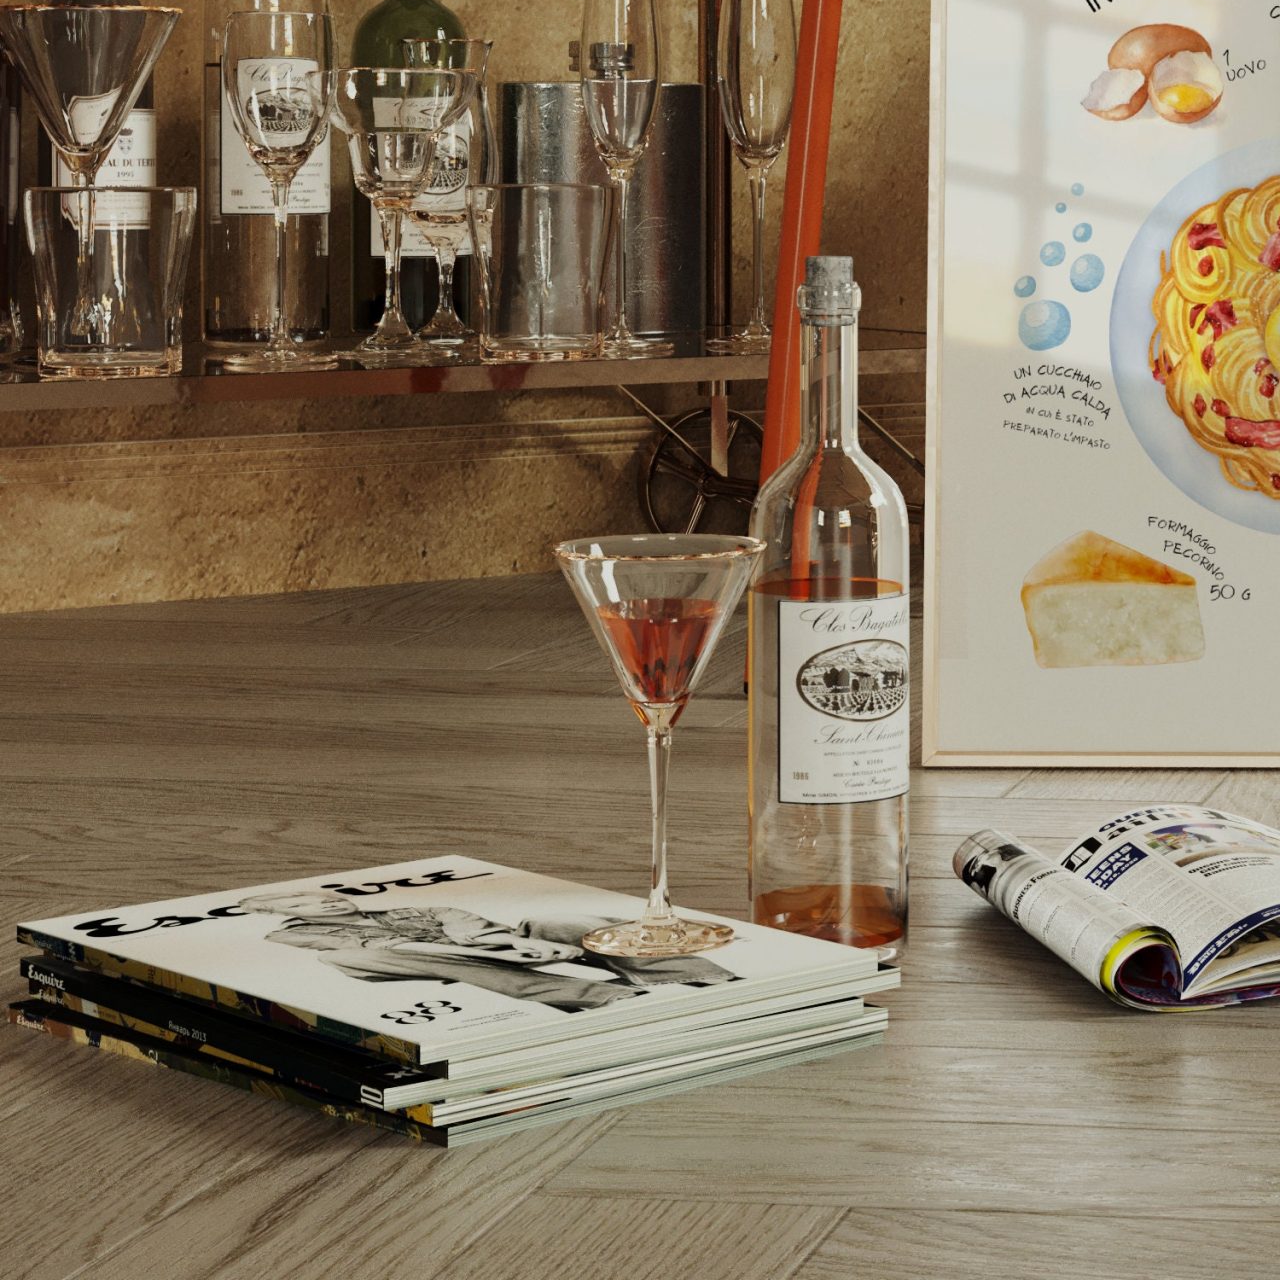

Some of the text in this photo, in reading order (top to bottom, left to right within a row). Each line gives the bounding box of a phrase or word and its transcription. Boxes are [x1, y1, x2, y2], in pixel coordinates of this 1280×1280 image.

[1222, 48, 1230, 67] 1
[1225, 59, 1267, 82] UOVO
[1013, 364, 1103, 391] UN CUCCHIAIO
[1002, 383, 1112, 421] DI ACQUA CALDA
[1147, 515, 1216, 555] FORMAGGIO
[1163, 539, 1225, 581] PECORINO
[1209, 584, 1251, 602] 50 G
[1089, 845, 1132, 880] EENS
[28, 964, 65, 991] Esquire
[380, 1000, 463, 1025] 88
